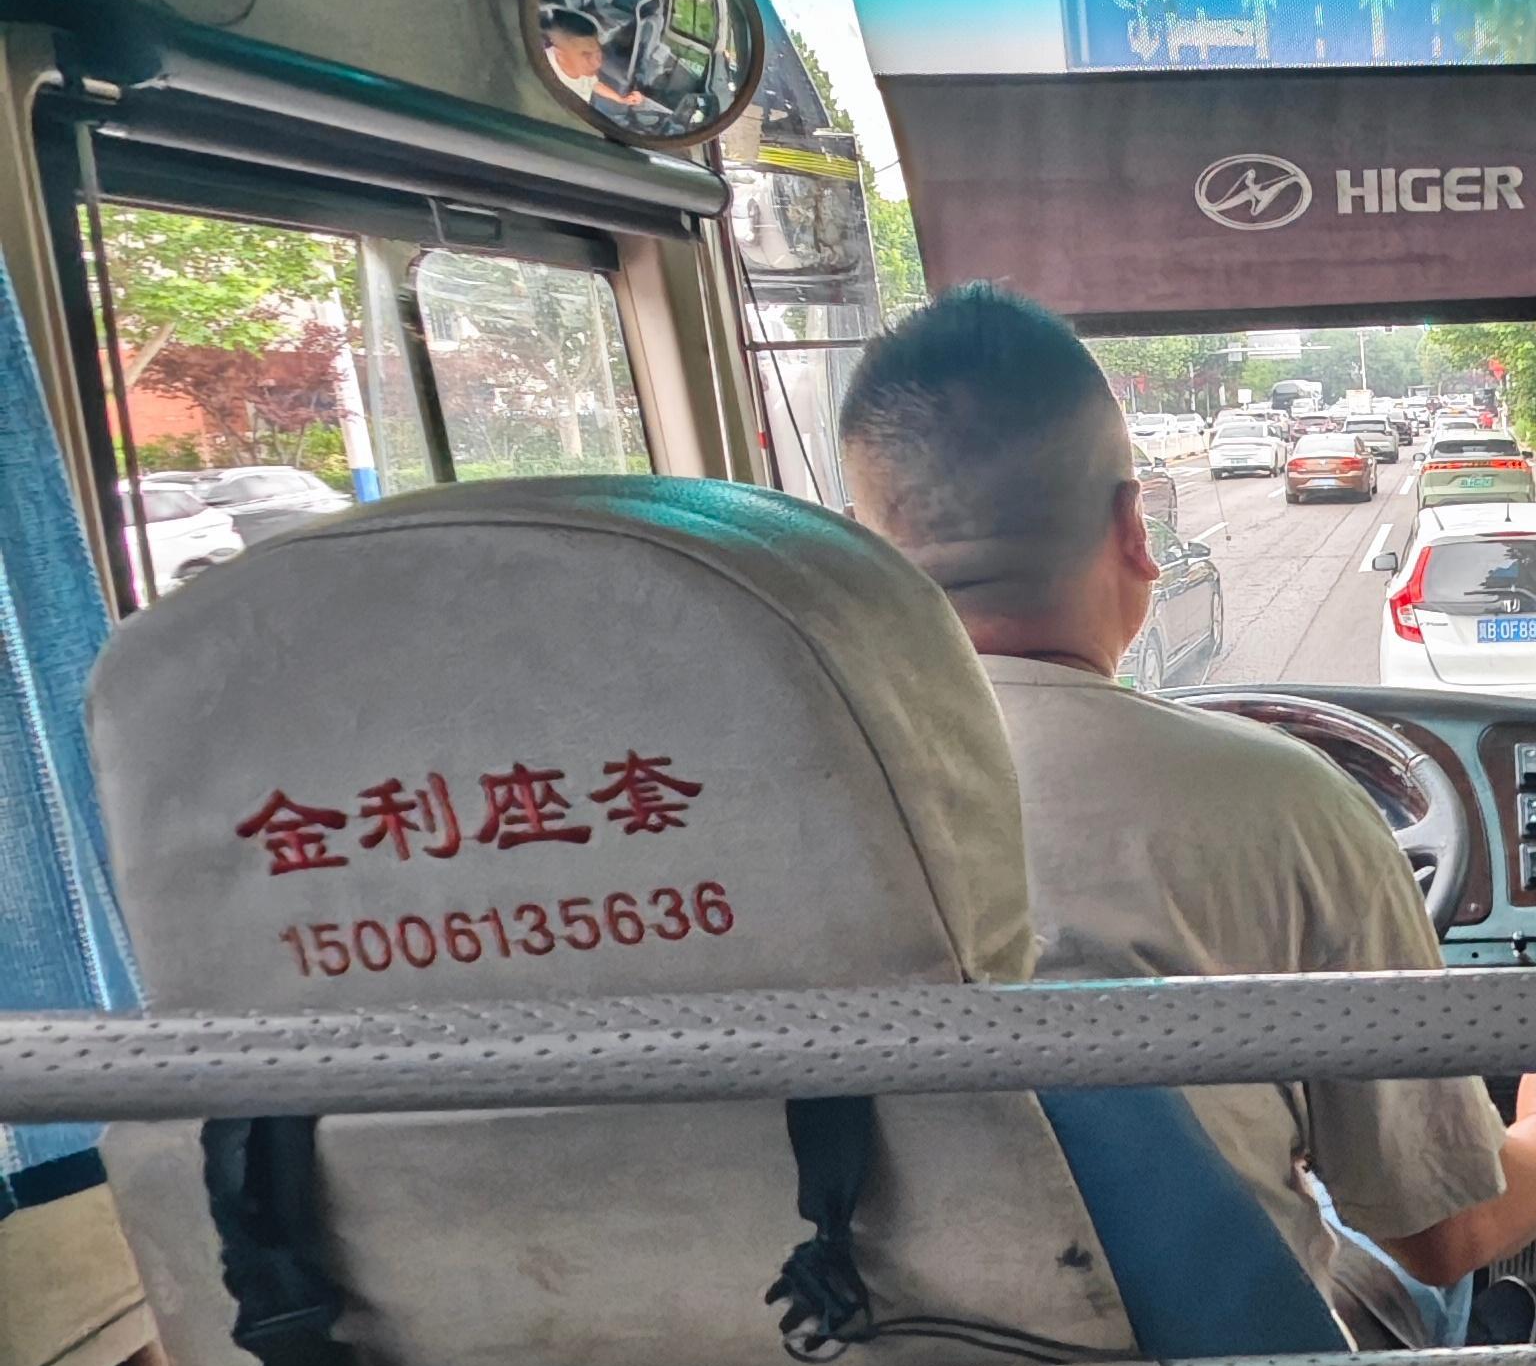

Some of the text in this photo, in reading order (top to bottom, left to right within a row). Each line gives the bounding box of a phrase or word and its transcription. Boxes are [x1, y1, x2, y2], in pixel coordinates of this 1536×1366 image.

[1336, 165, 1525, 214] HIGER
[236, 749, 702, 875] 金利座套
[280, 881, 735, 976] 15006135636
